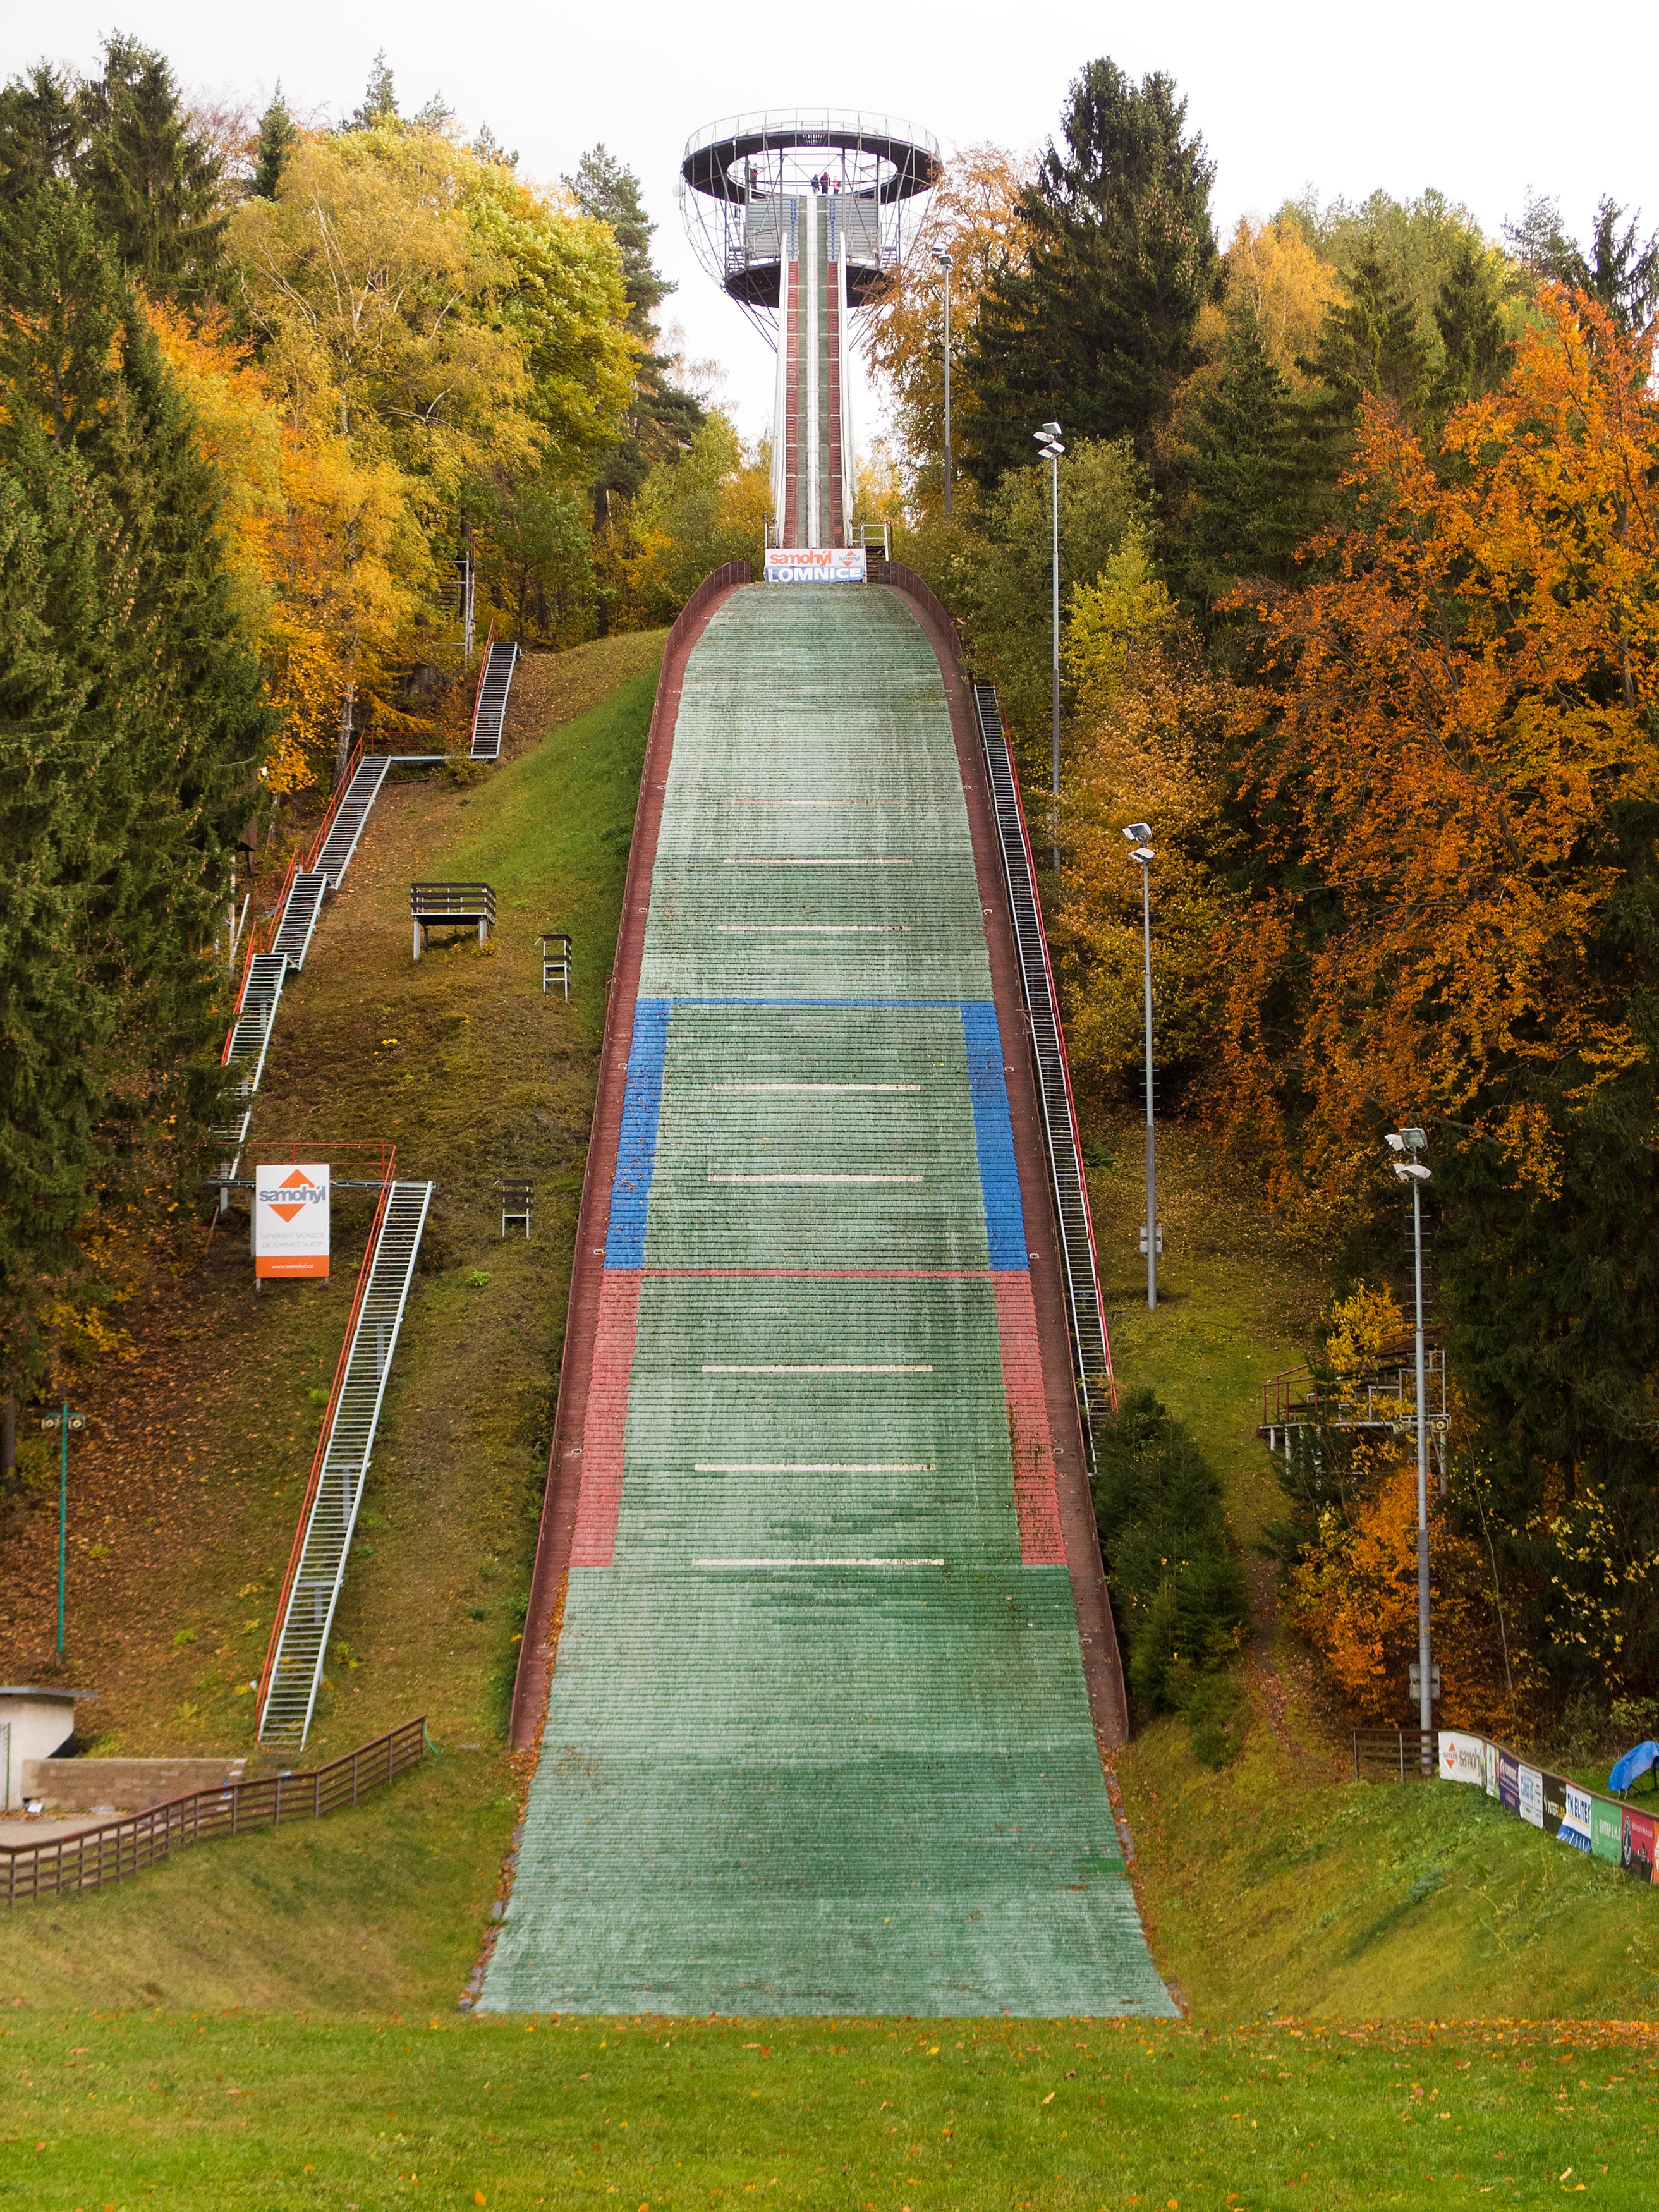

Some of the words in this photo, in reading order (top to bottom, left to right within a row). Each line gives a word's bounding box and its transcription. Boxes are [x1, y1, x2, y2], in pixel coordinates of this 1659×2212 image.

[770, 550, 832, 566] samohýl
[768, 568, 861, 582] LOMNICE
[259, 1186, 326, 1204] samohýl
